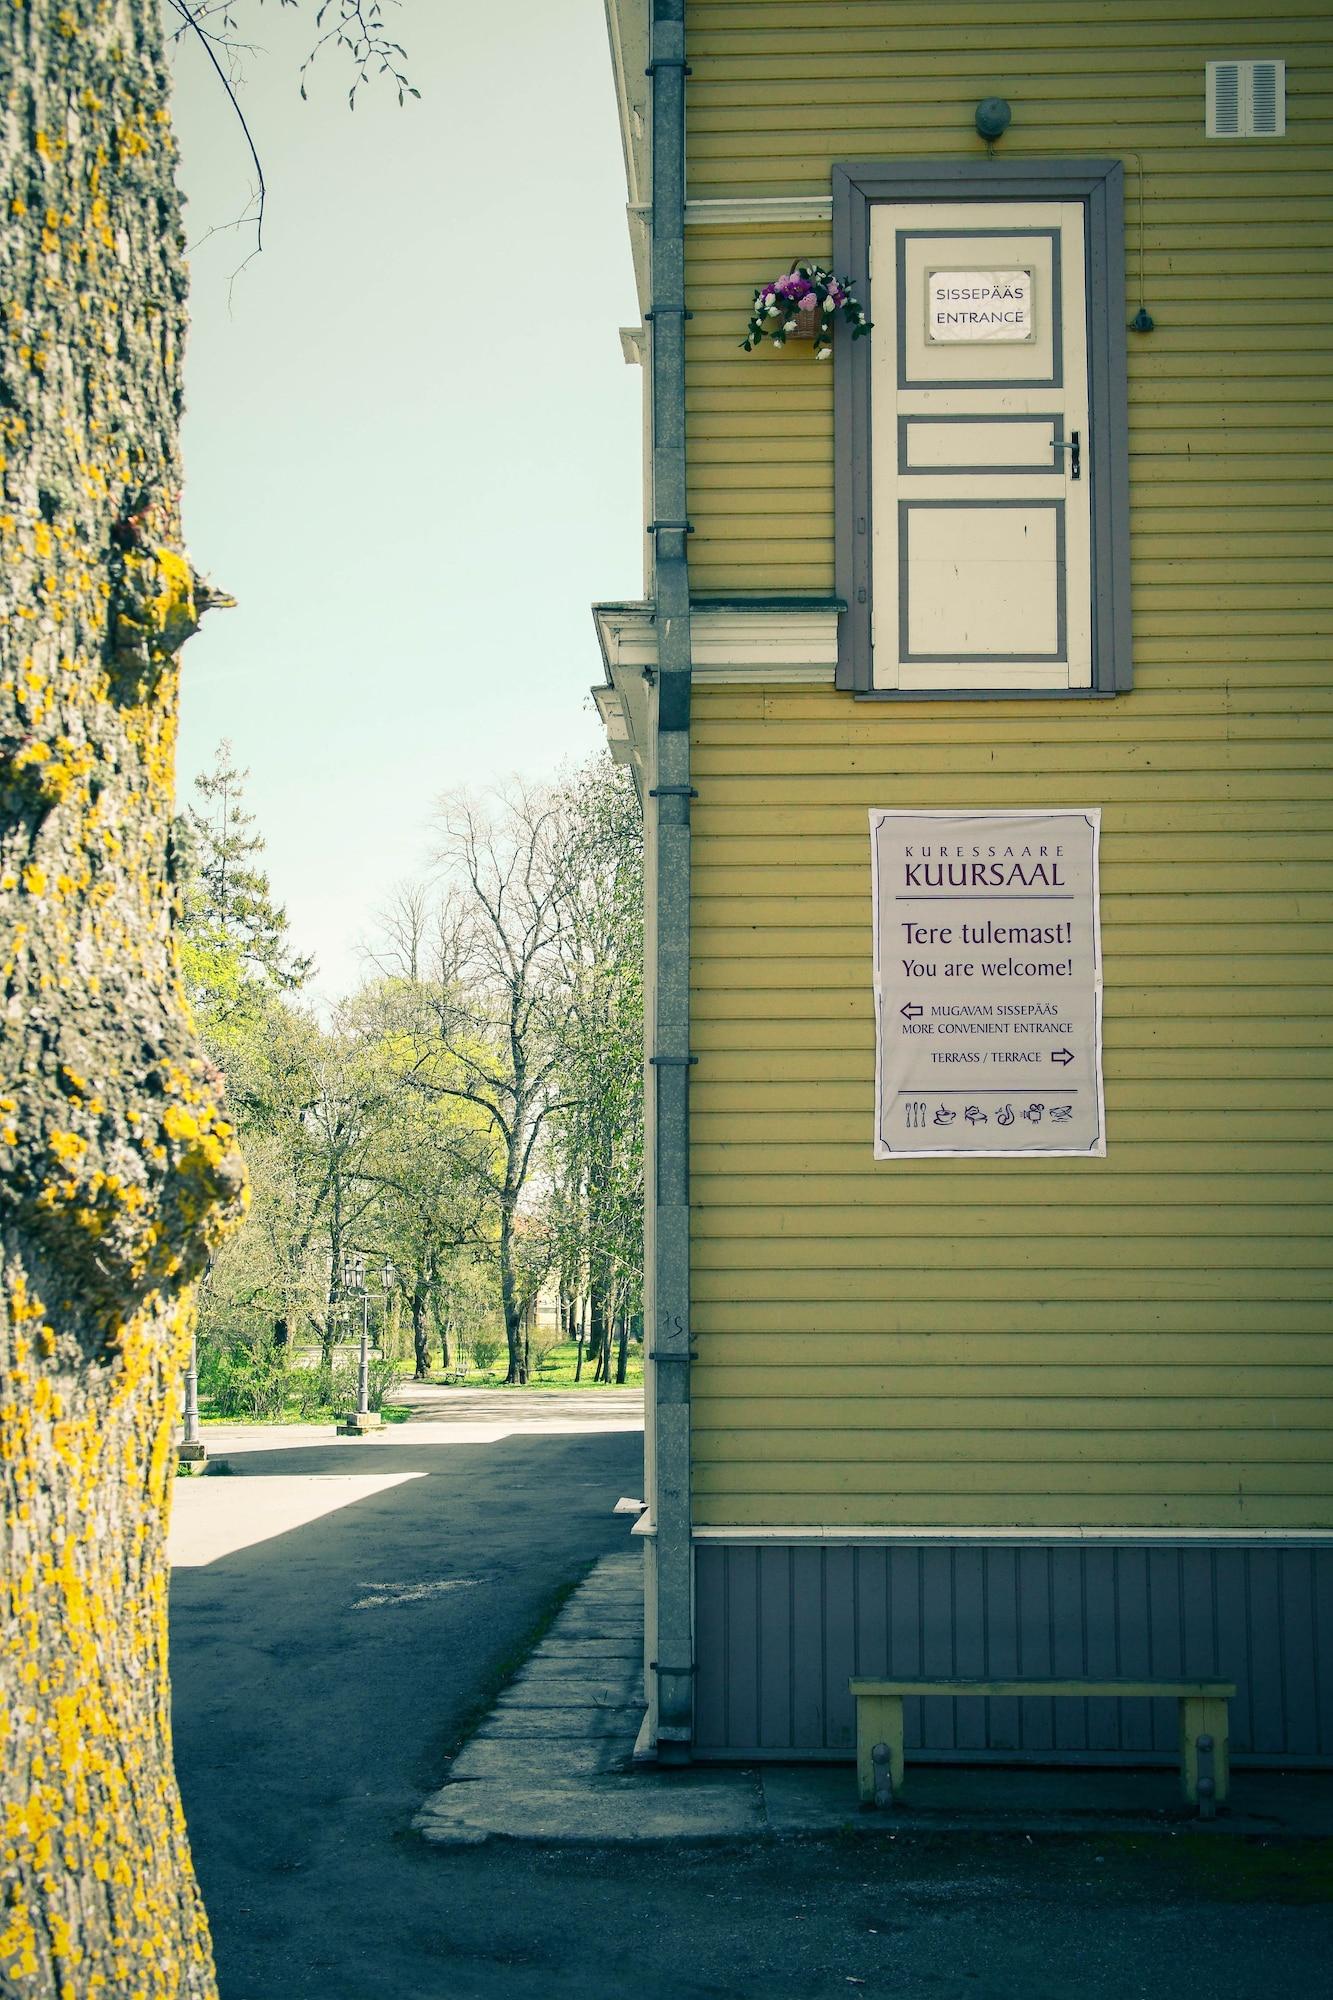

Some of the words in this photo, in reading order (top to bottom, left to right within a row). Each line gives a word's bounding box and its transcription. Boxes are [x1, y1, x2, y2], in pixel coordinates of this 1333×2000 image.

[936, 285, 1024, 300] SISSEPÄÄS
[937, 311, 1024, 324] ENTRANCE
[905, 845, 1064, 857] KURESSAARE
[905, 863, 1065, 887] KUURSAAL
[901, 922, 953, 944] Tere
[961, 920, 1072, 944] tulemast!
[901, 959, 937, 977] You
[944, 963, 974, 977] are
[981, 957, 1073, 977] welcome!
[931, 1005, 994, 1016] MUGAVAM
[997, 1002, 1059, 1016] SISSEPÄÄS
[902, 1023, 935, 1034] MORE
[937, 1022, 1011, 1034] CONVENIENT
[1013, 1022, 1074, 1033] ENTRANCE
[931, 1052, 980, 1063] TERRASS
[991, 1052, 1042, 1063] TERRACE
